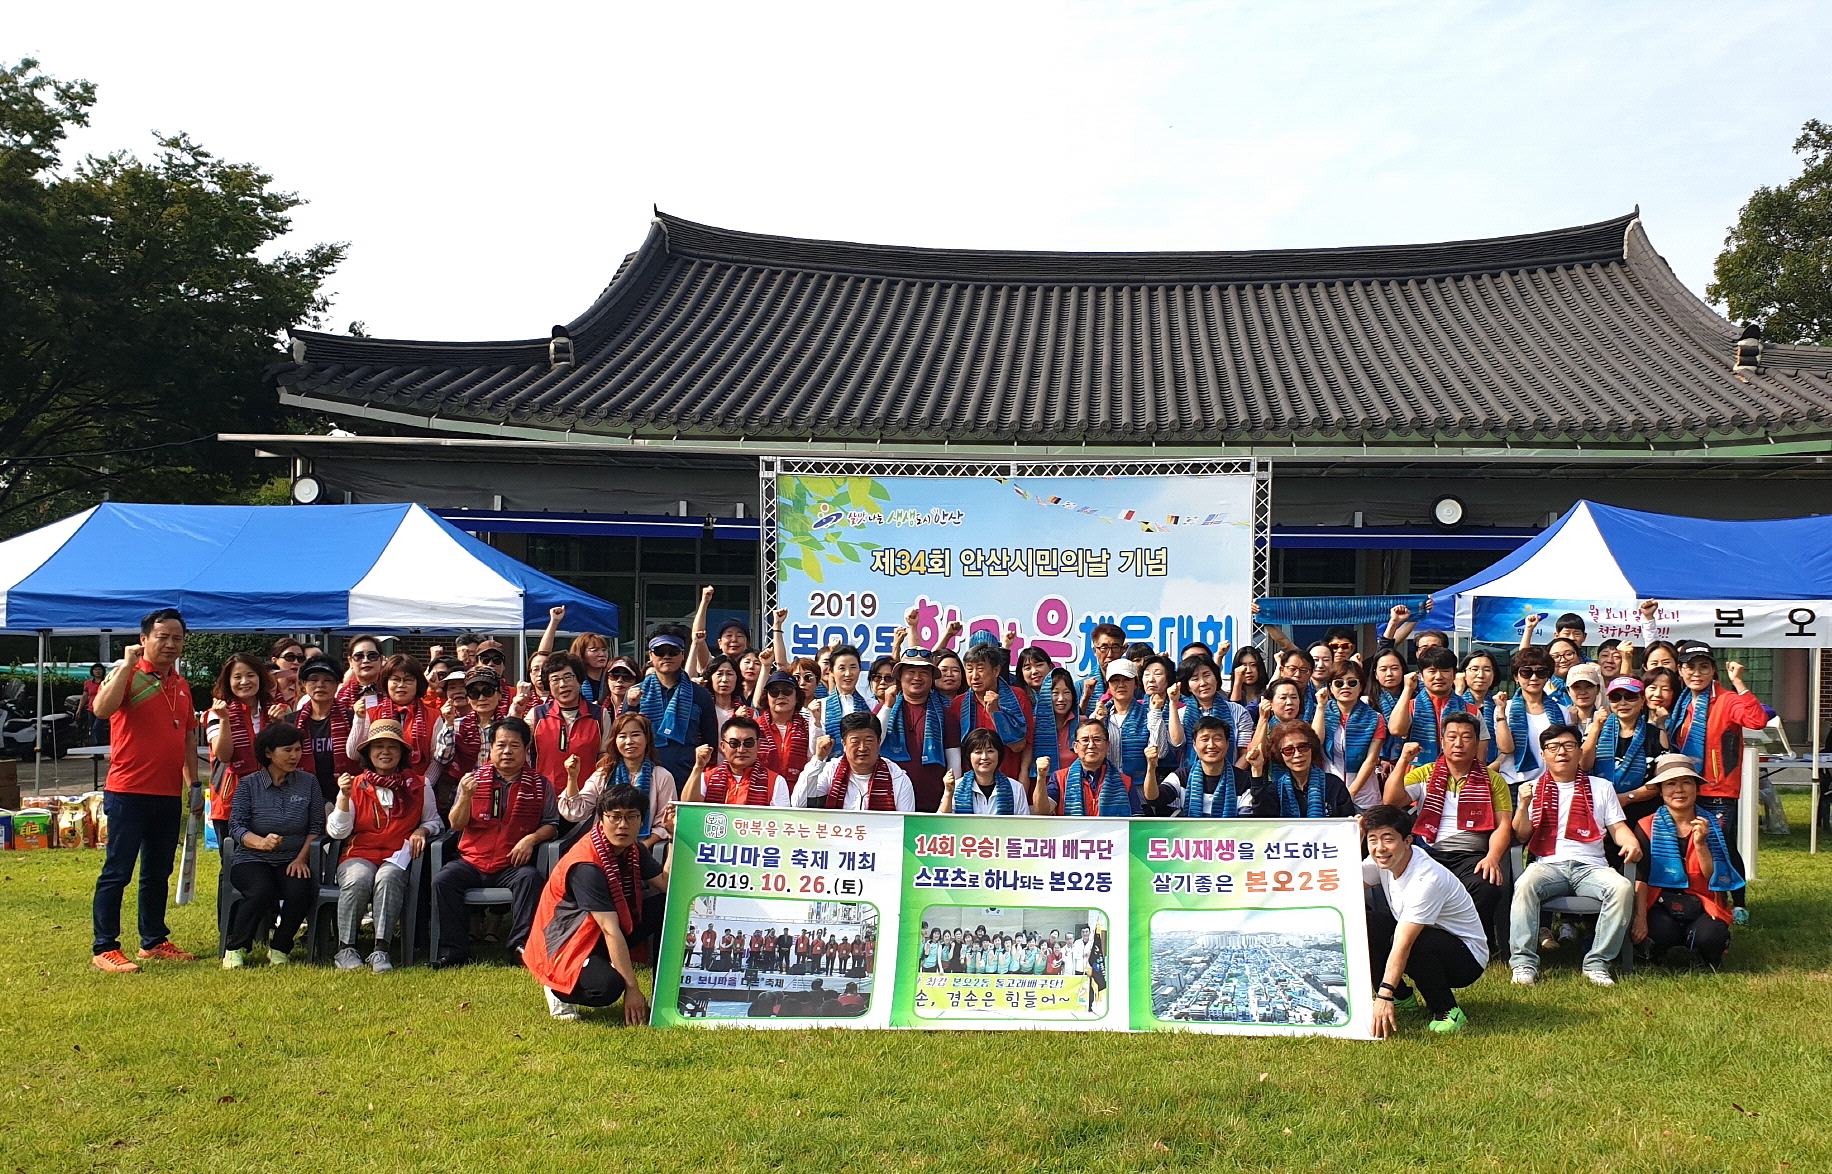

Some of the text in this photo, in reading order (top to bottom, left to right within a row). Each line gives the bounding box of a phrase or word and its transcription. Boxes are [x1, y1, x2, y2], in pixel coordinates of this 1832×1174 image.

[932, 509, 964, 526] 안산
[870, 546, 1168, 577] 제34회 안산시민의날 기념
[809, 592, 877, 617] 2019
[1598, 624, 1643, 639] 천하무적
[734, 819, 868, 841] 행복을 주는 본오2동
[696, 843, 876, 871] 보니마을 축제 개최
[915, 836, 1114, 860] 14회 우승! 돌고래 배구단
[1148, 839, 1339, 861] 도시재생을 선도하는
[705, 872, 754, 891] 2019.
[761, 873, 791, 893] 10.
[915, 867, 1113, 892] 스포츠로 하나되는 본오2동
[1153, 869, 1341, 893] 살기좋은 본오2동
[680, 975, 692, 985] 18
[946, 989, 996, 1008] 겸손은
